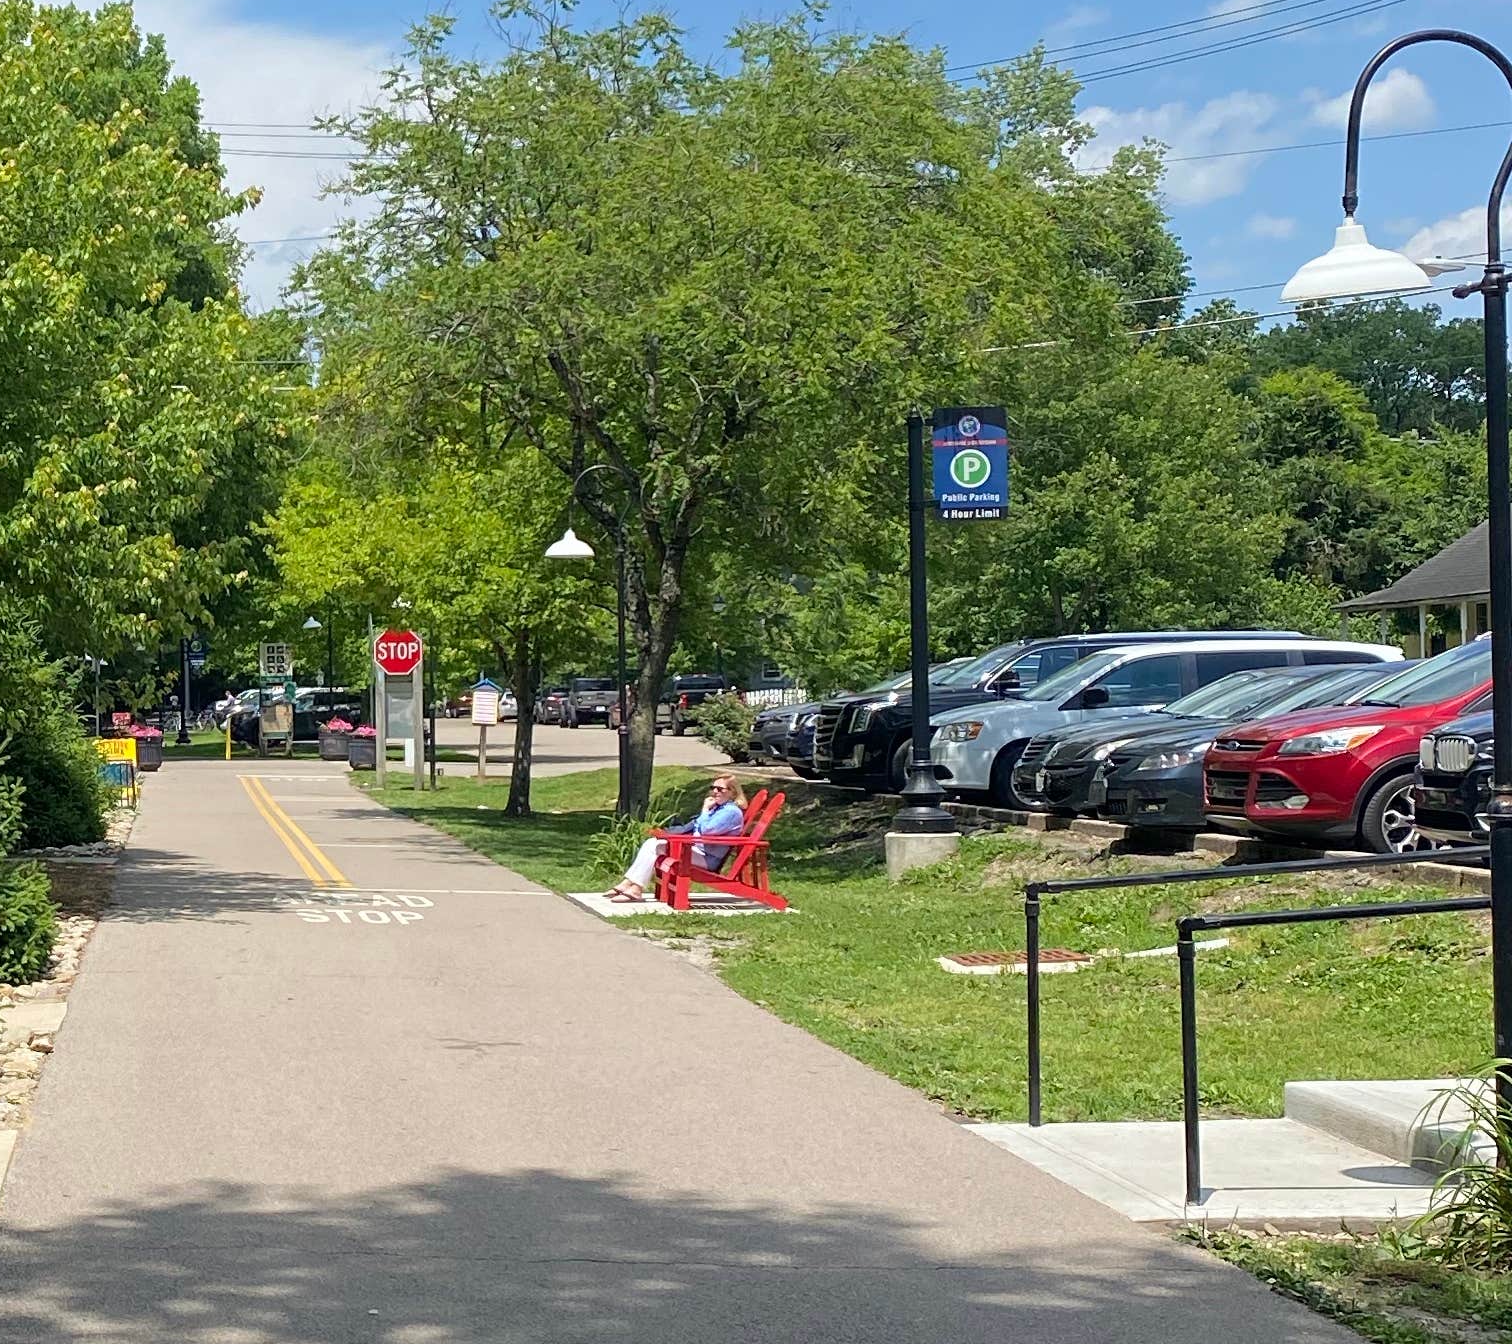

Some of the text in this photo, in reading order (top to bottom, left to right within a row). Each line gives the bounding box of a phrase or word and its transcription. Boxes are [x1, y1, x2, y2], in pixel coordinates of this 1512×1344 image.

[963, 457, 981, 481] P
[942, 492, 1000, 502] Public Parking
[942, 508, 1000, 518] 4 Hour Limit
[378, 642, 419, 660] STOP
[295, 908, 424, 925] STOP
